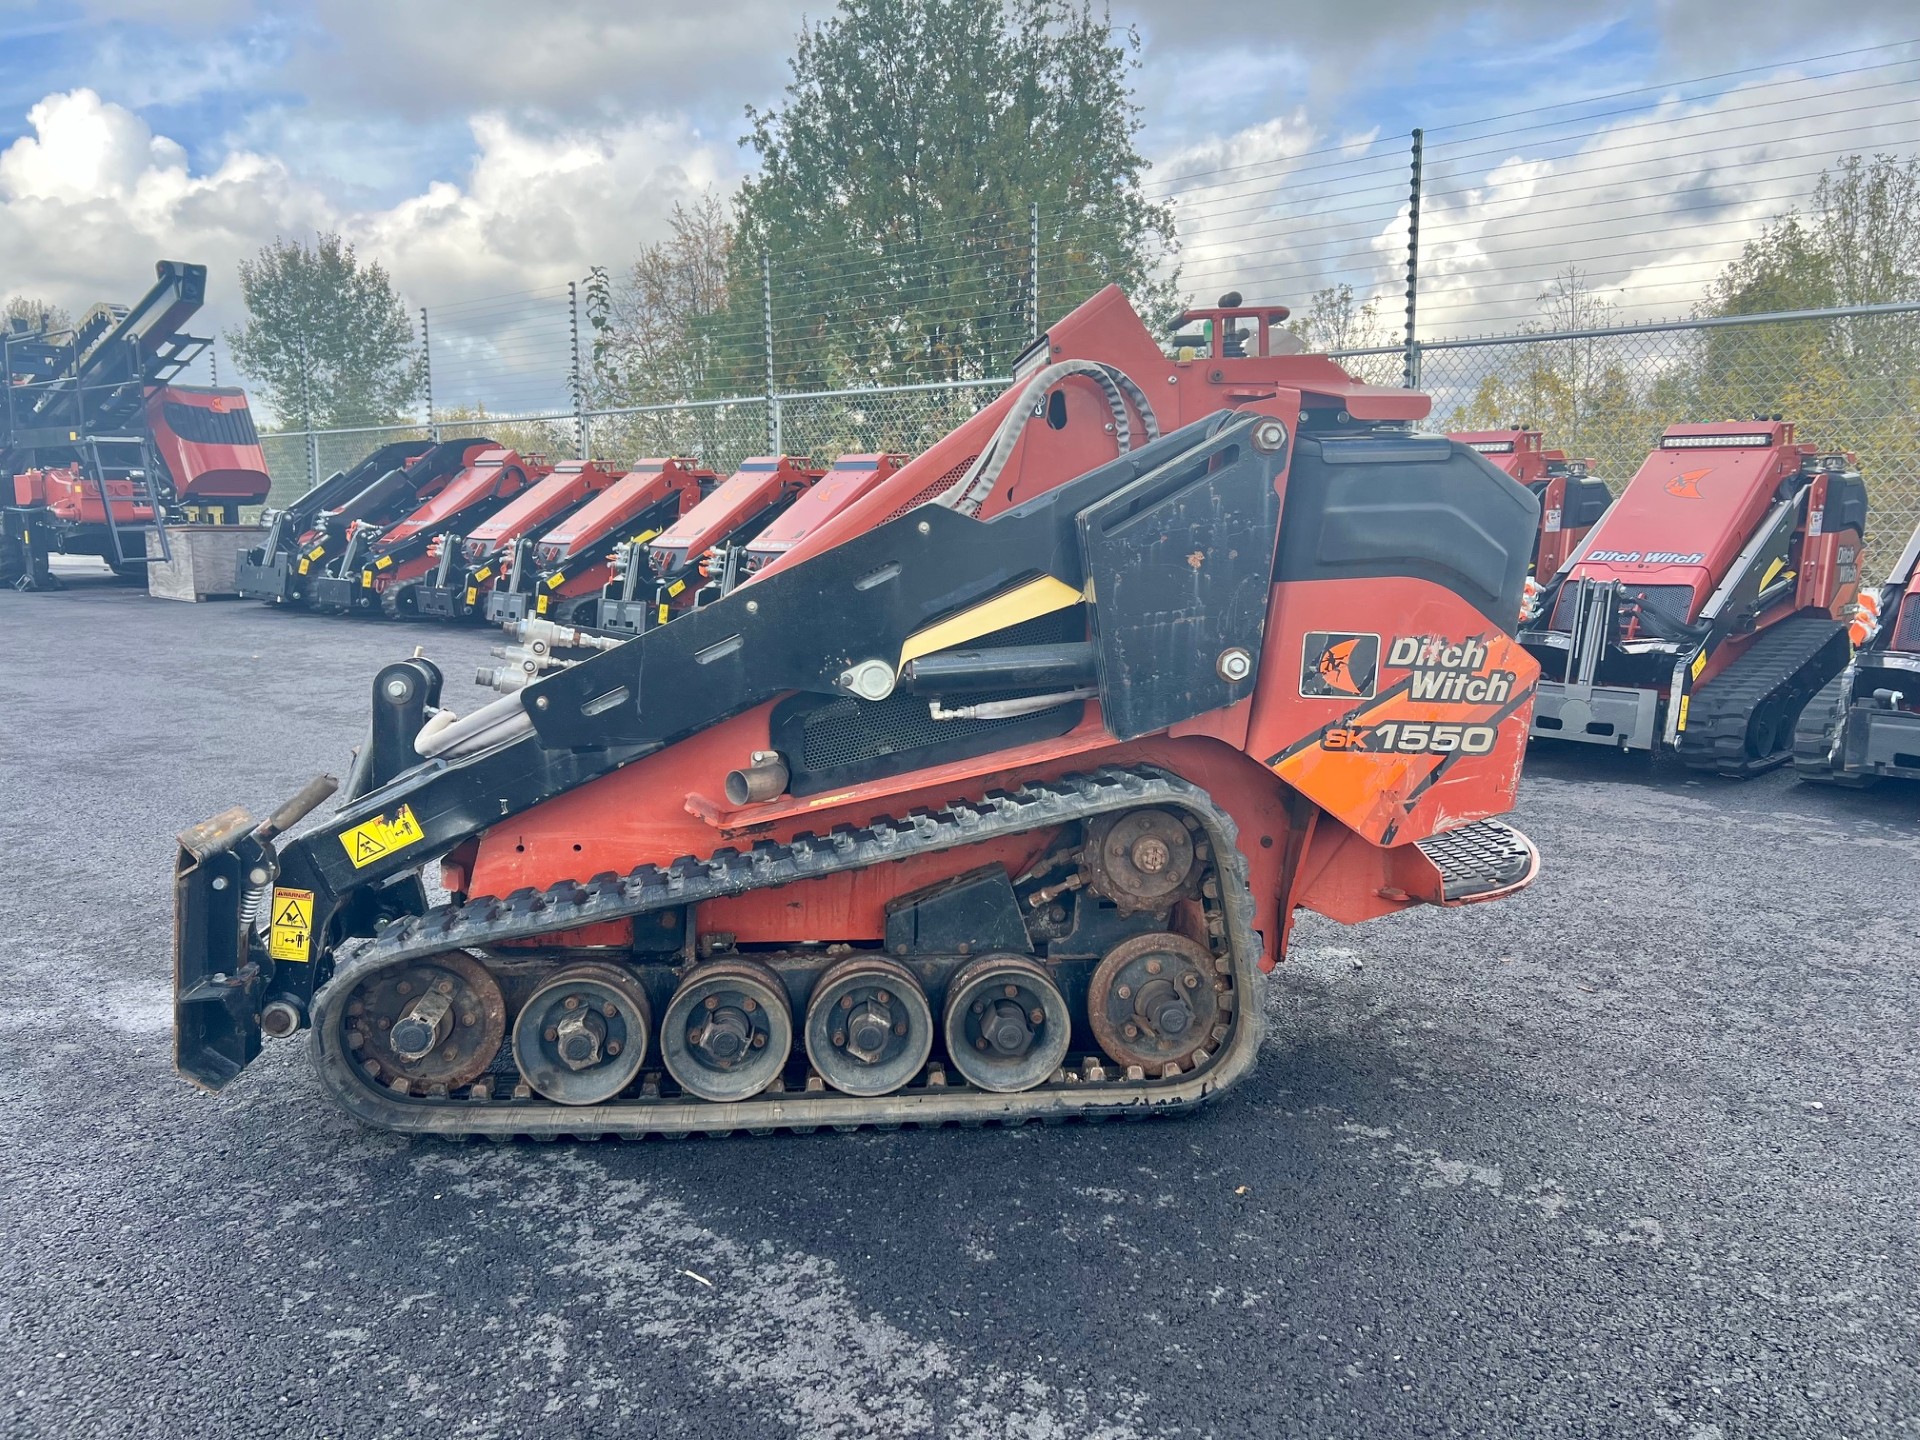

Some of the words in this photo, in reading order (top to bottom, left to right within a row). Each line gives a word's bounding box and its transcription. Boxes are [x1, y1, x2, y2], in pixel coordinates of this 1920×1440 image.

[1586, 550, 1640, 562] Ditch
[1643, 552, 1703, 564] Witch
[1388, 637, 1485, 668] Ditch
[1412, 670, 1508, 702] Witch
